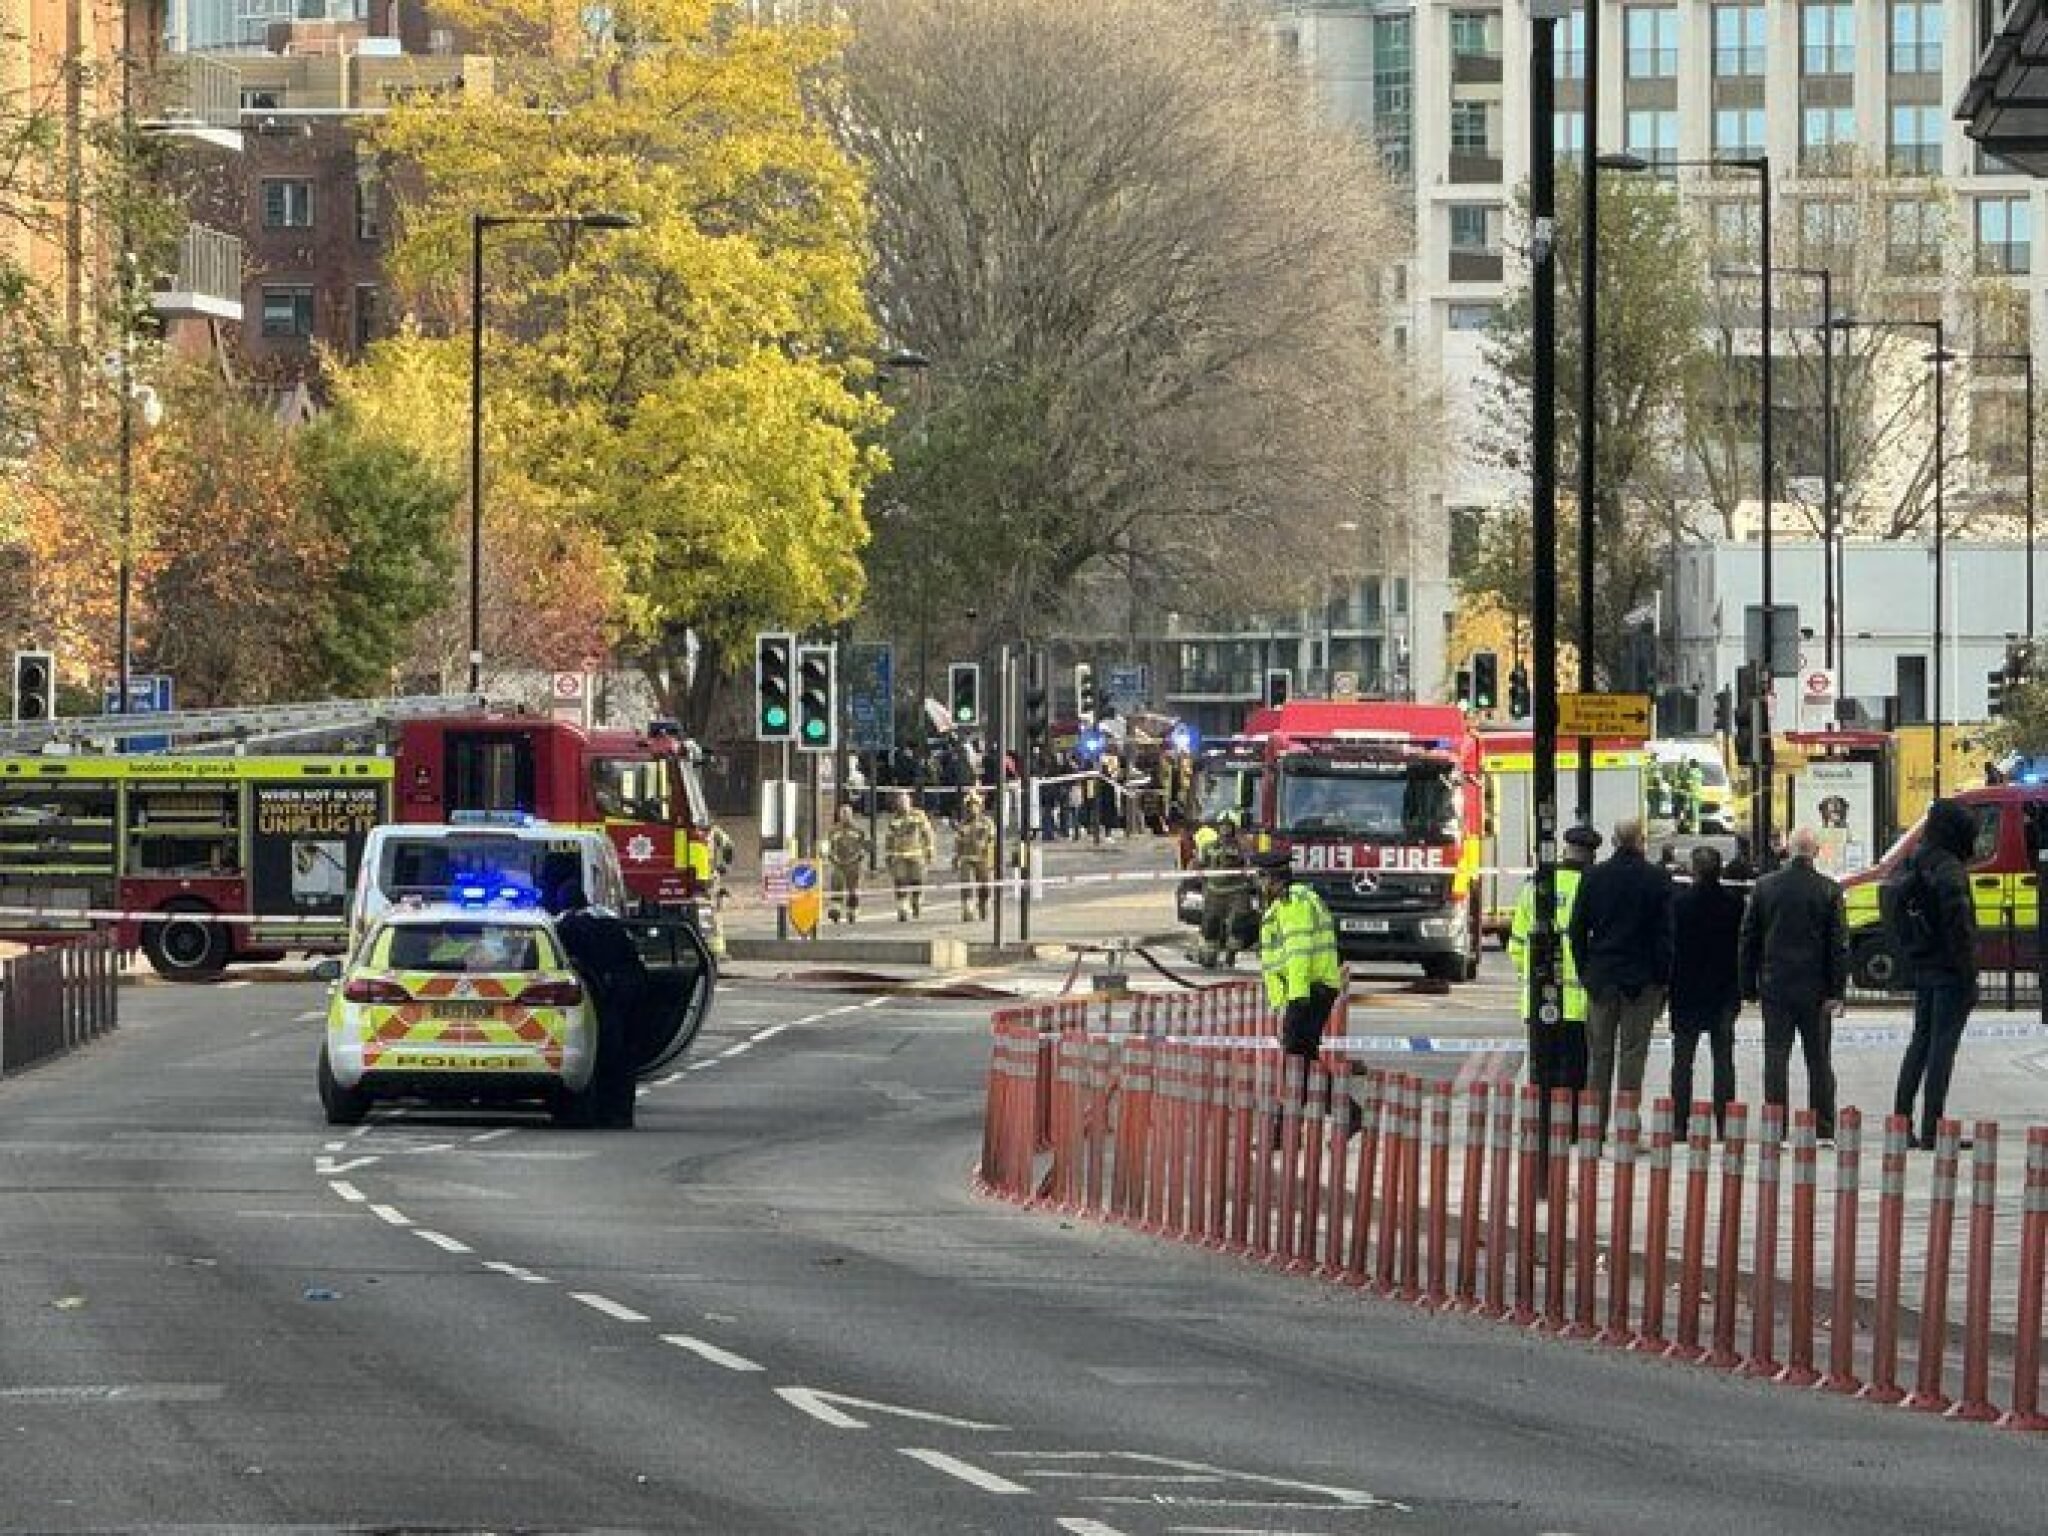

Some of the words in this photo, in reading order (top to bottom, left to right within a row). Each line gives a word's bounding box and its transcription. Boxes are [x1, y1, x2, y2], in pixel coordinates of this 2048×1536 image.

[259, 790, 301, 801] WHEN
[303, 790, 330, 801] NOT
[350, 790, 377, 801] USE
[259, 803, 322, 814] SWITCH
[327, 803, 343, 814] IT
[346, 803, 377, 815] OFF
[259, 816, 350, 832] UNPLUG
[355, 816, 377, 832] IT
[1381, 846, 1444, 870] FIRE
[396, 1056, 529, 1067] POLICE
